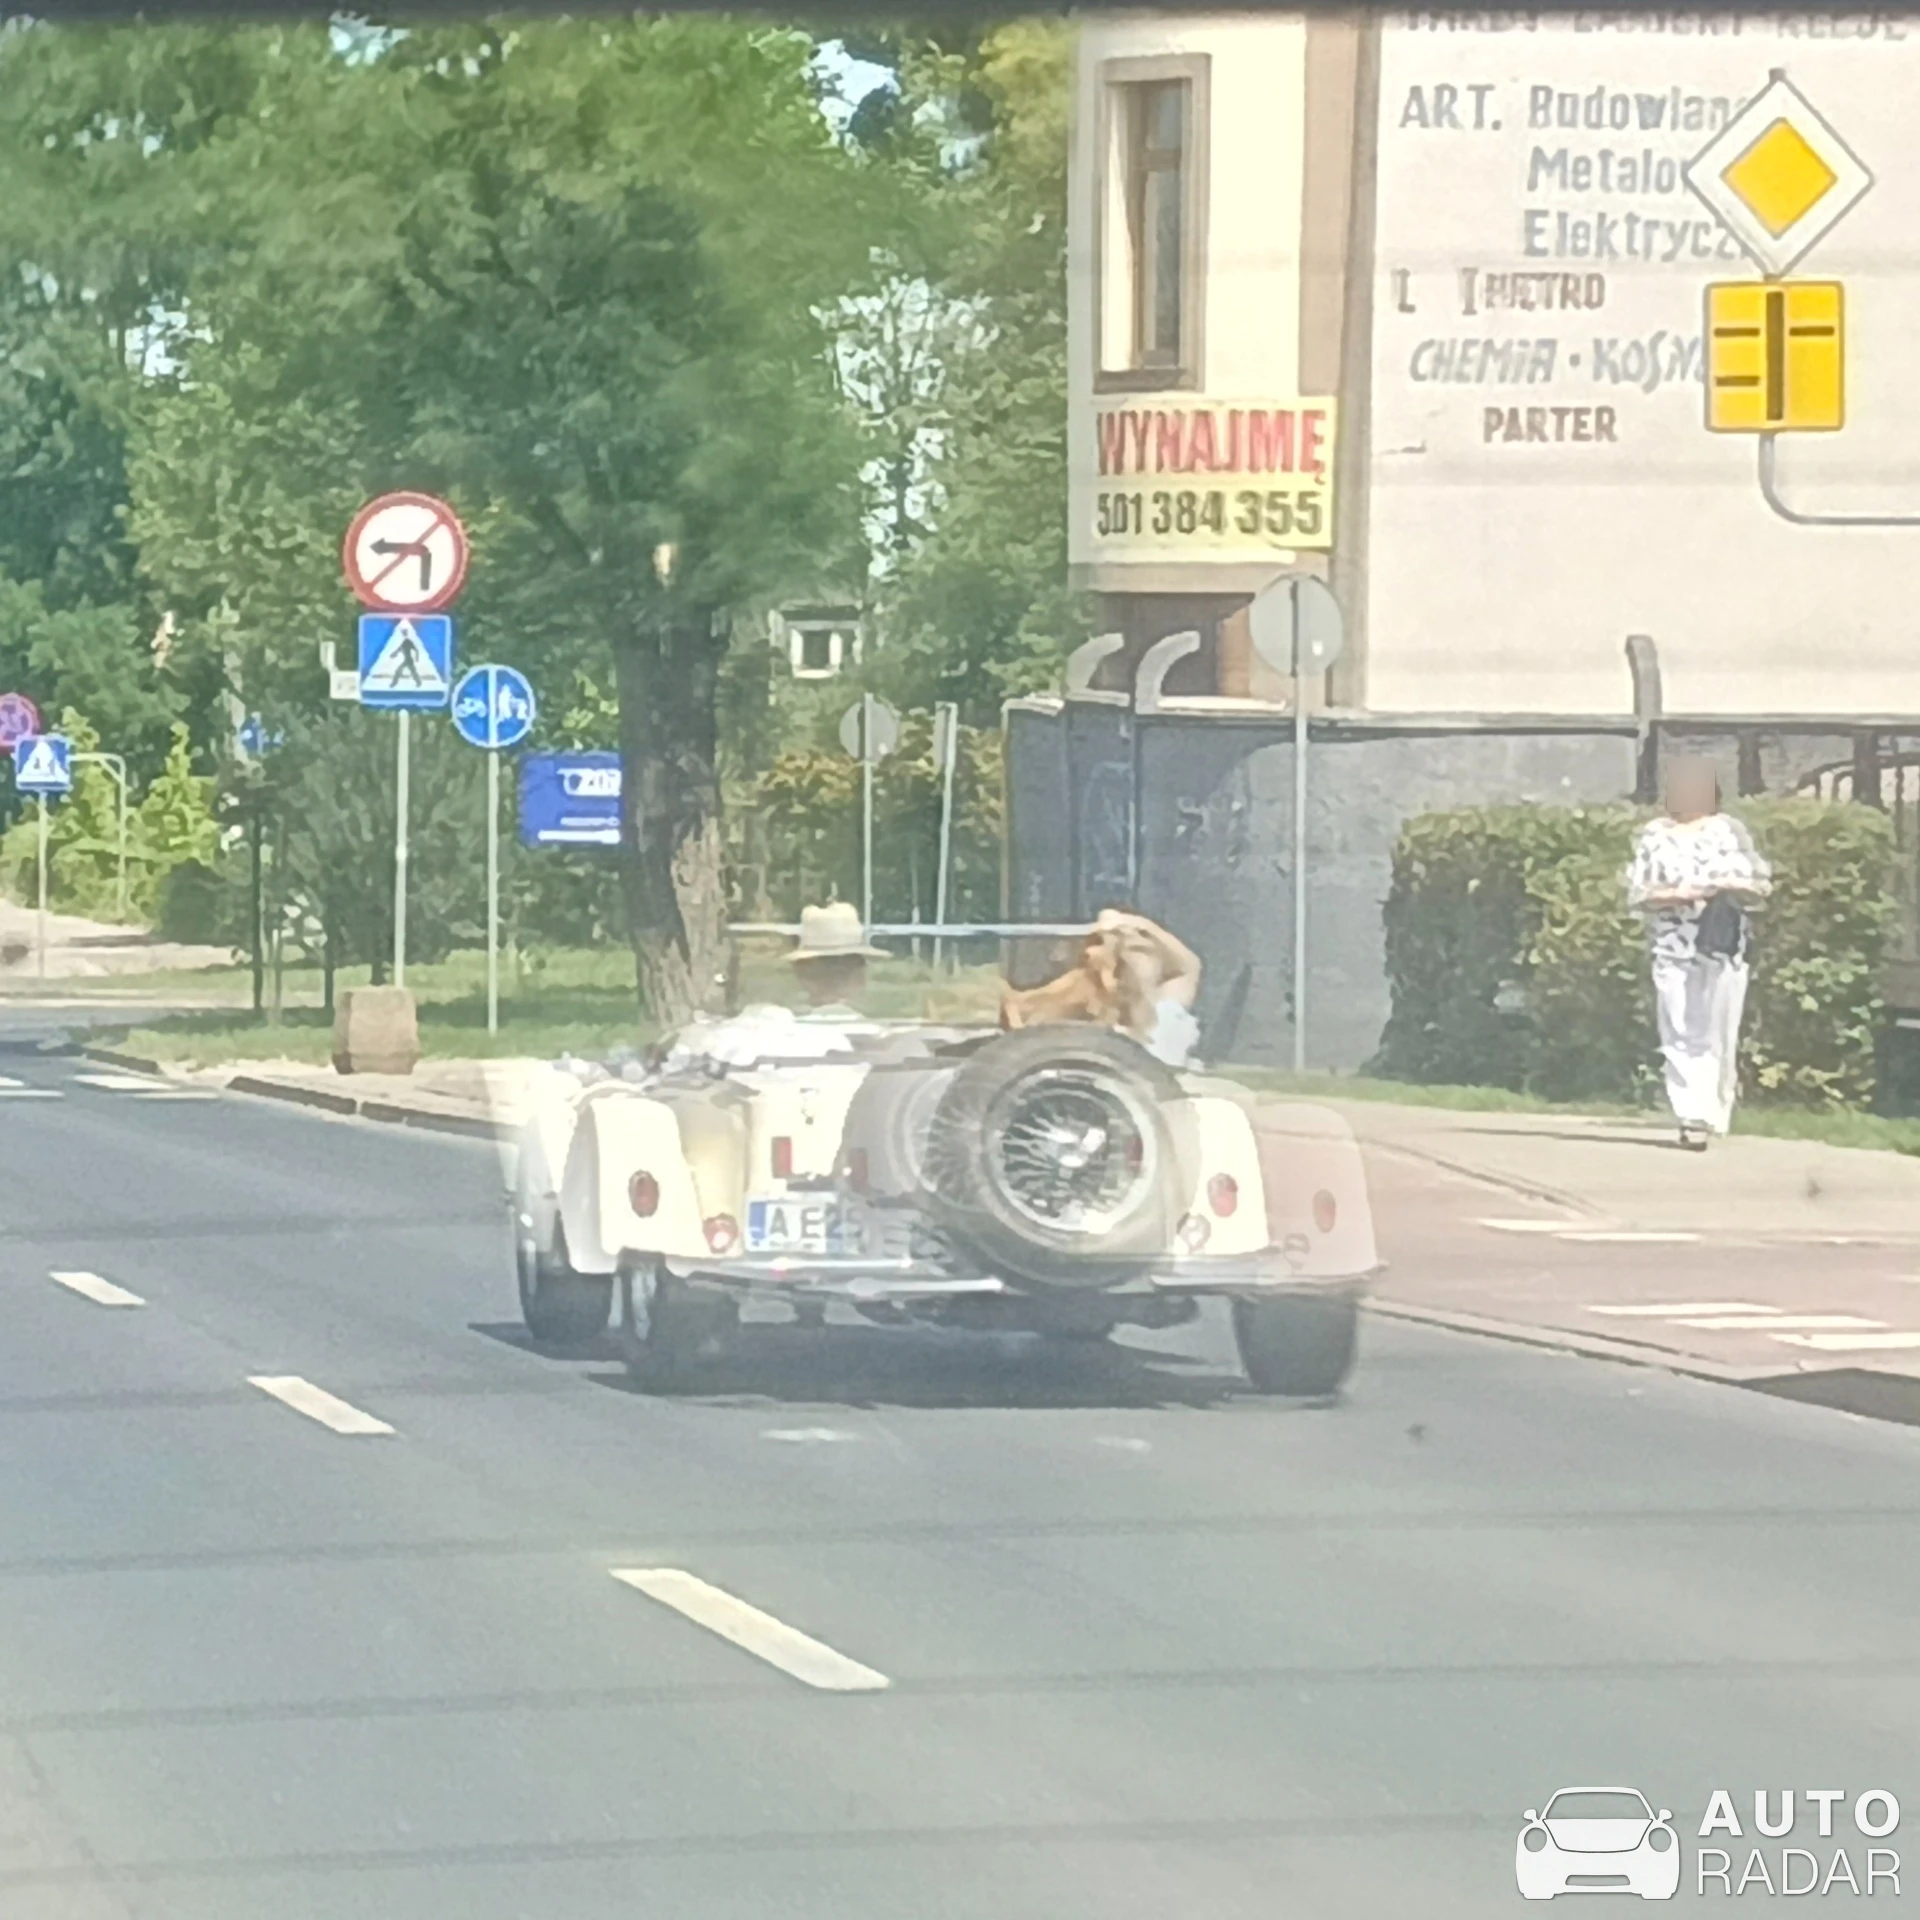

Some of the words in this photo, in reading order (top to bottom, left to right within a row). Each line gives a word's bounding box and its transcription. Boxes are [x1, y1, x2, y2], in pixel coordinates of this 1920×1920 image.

[1399, 83, 1502, 131] ART.
[1528, 85, 1748, 131] Budowlan
[1526, 145, 1690, 194] Metalo
[1523, 209, 1749, 262] Elektrycz
[1593, 330, 1703, 394] KOSM
[1097, 409, 1326, 485] WYNAJMĘ
[1484, 406, 1618, 443] PARTER
[1097, 491, 1143, 536] 501
[1152, 490, 1227, 536] 384
[1234, 490, 1323, 536] 355
